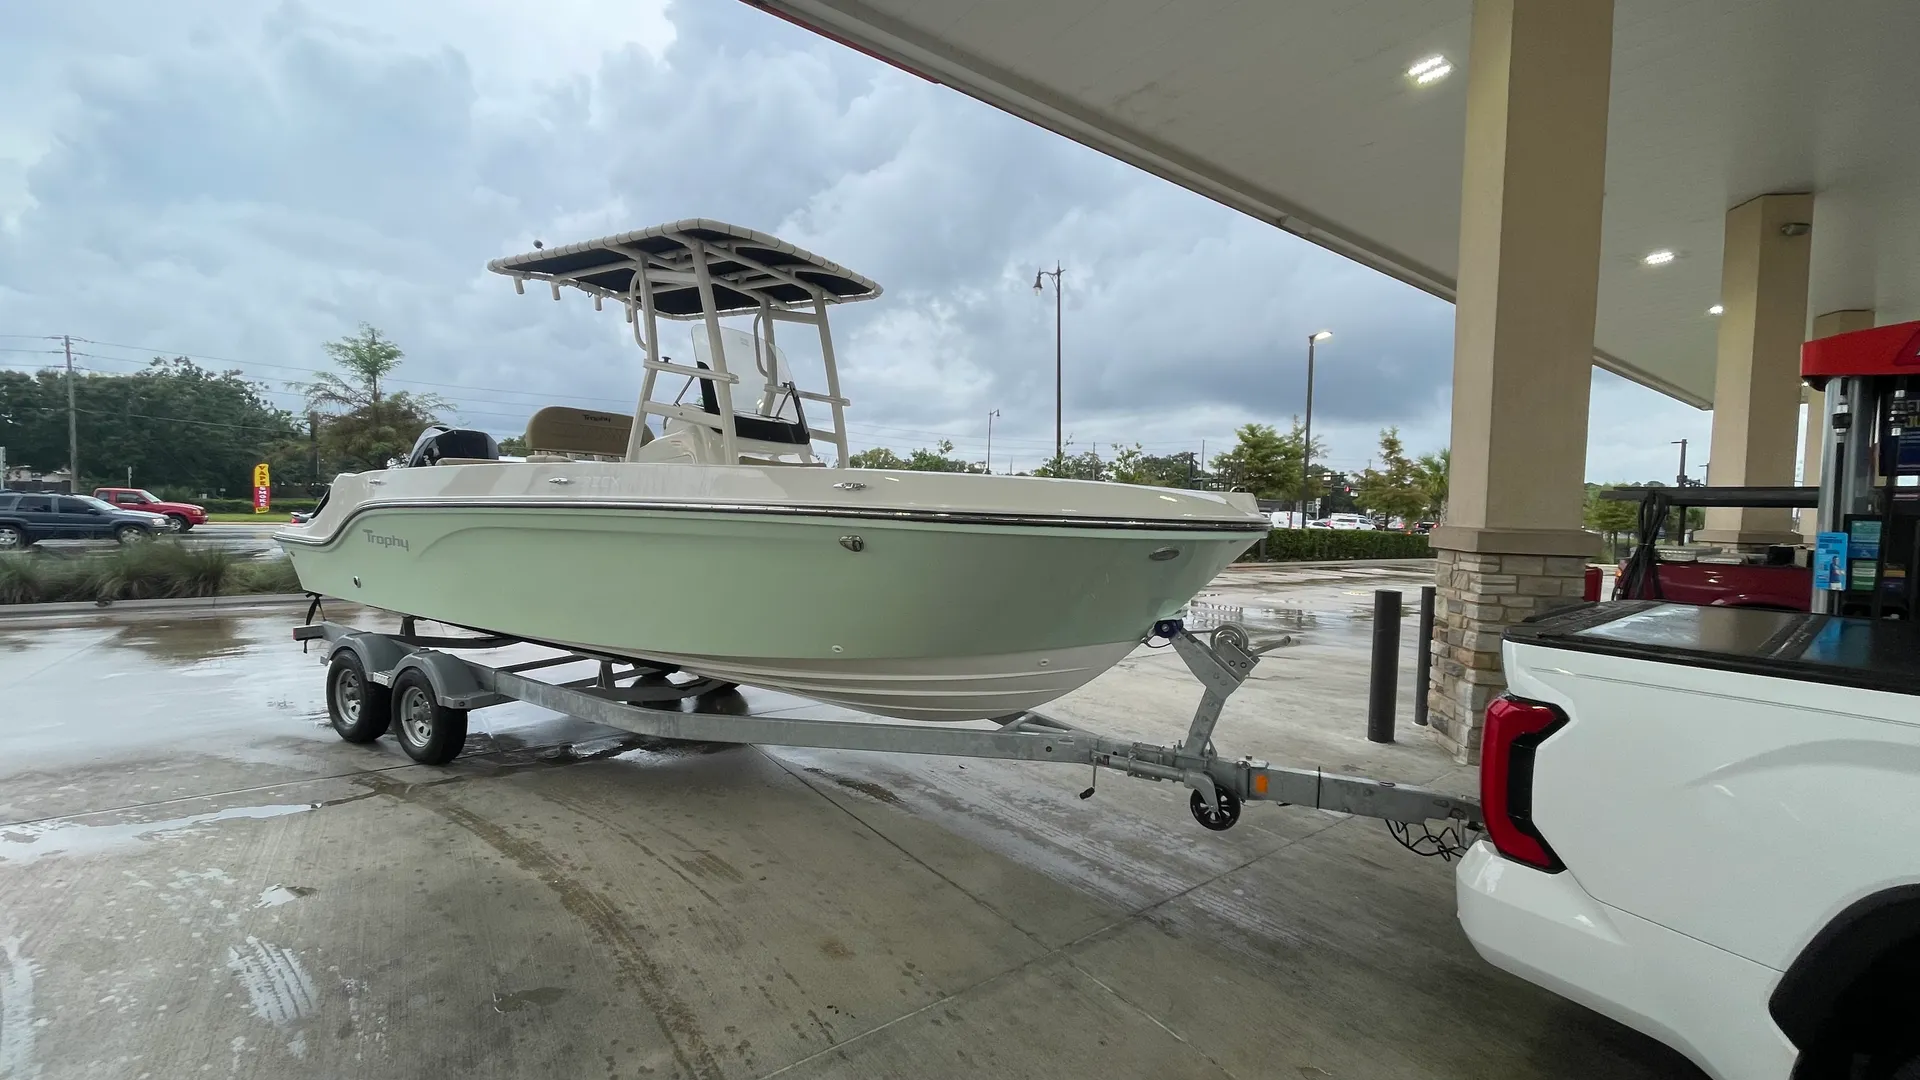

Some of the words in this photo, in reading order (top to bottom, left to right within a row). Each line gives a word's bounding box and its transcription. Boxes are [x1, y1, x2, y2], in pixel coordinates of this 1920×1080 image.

[582, 414, 611, 423] Trophy
[258, 465, 267, 486] VAPE
[258, 486, 267, 507] SMOKE
[362, 528, 409, 552] Trophy
